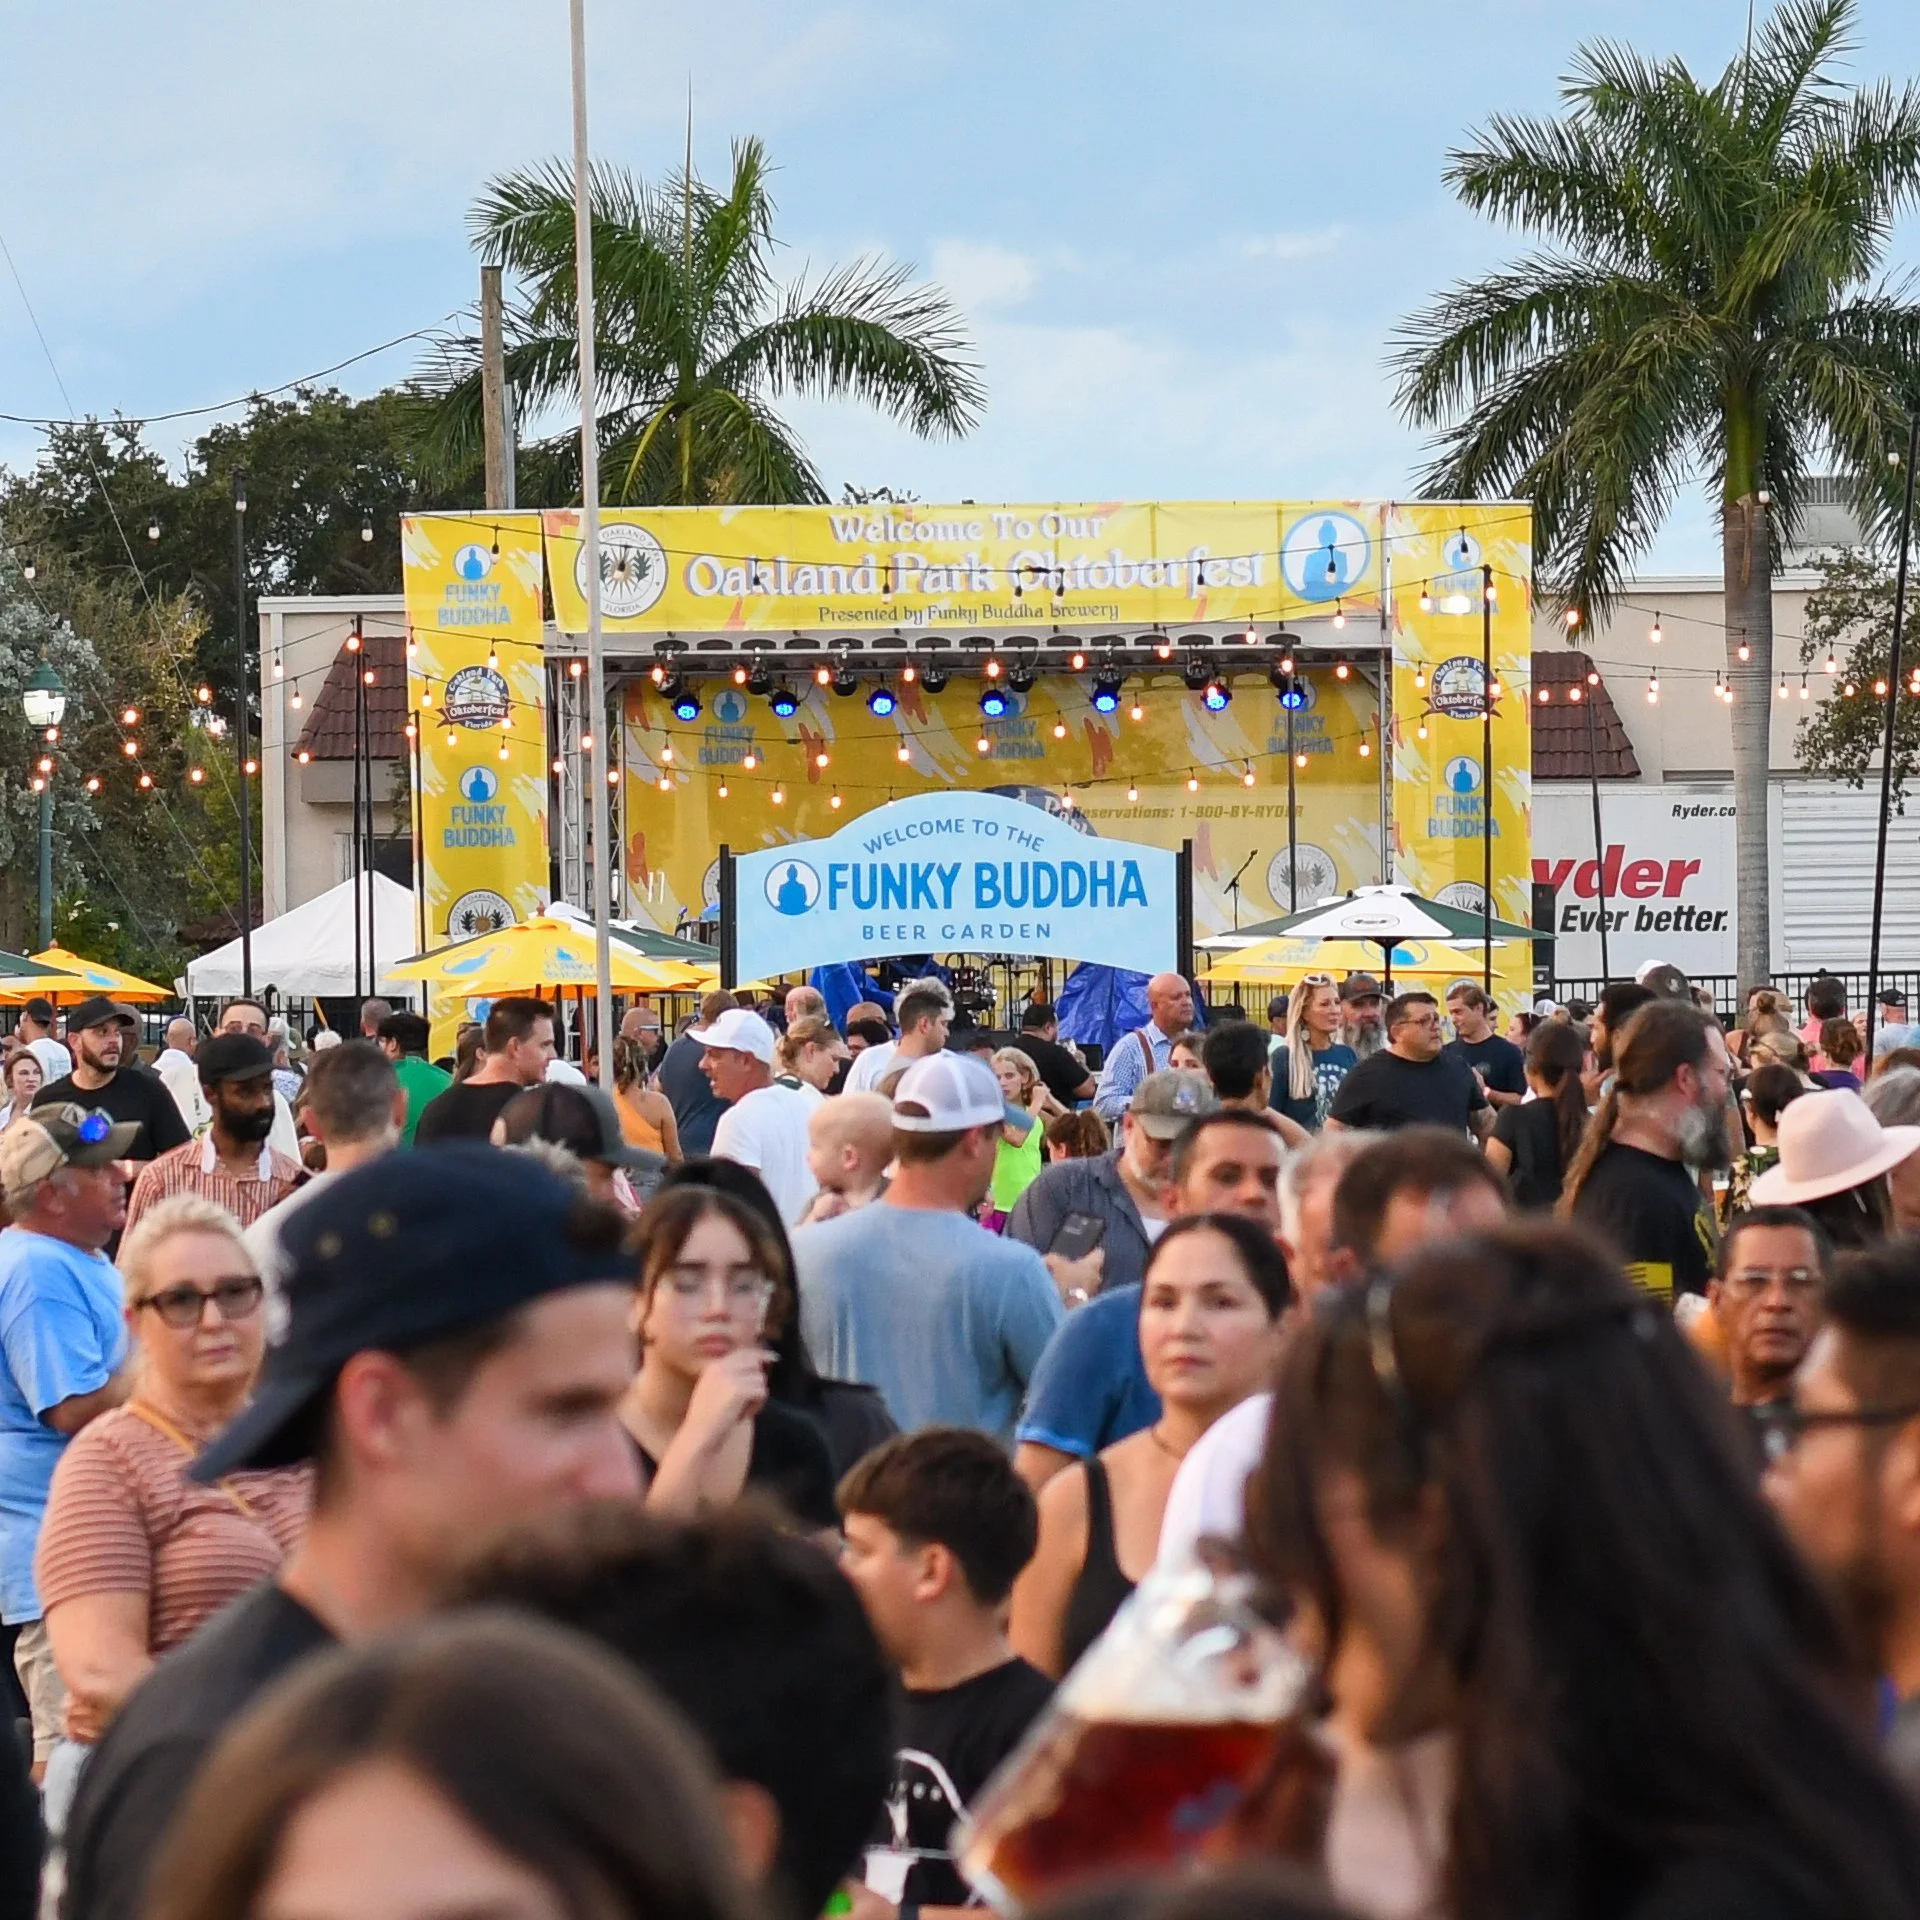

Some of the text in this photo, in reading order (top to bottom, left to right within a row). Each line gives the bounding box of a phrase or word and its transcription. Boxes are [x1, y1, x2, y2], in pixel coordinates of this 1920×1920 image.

[829, 512, 1106, 543] Welcome To Our
[682, 550, 998, 597] Oakland Park
[1010, 546, 1266, 600] Oktoberfest
[445, 584, 501, 603] FUNKY
[438, 606, 512, 627] BUDDHA
[605, 603, 642, 613] FLORIDA
[819, 606, 897, 622] Presented
[903, 604, 923, 625] by
[928, 604, 978, 624] Funky
[982, 603, 1044, 619] Buddha
[450, 704, 506, 717] Oktoberfest
[1435, 694, 1485, 707] Oktoberfe
[452, 805, 507, 825] FUNKY
[1180, 805, 1304, 818] 1-800-BY-RYDR
[1672, 804, 1737, 819] Ryder.co
[444, 827, 516, 848] BUDDHA
[863, 818, 1045, 854] WELCOME TO THE
[1531, 844, 1702, 899] yder
[828, 860, 1149, 910] FUNKY BUDDHA
[1560, 905, 1728, 932] Ever better.
[862, 923, 1051, 940] BEER GARDEN
